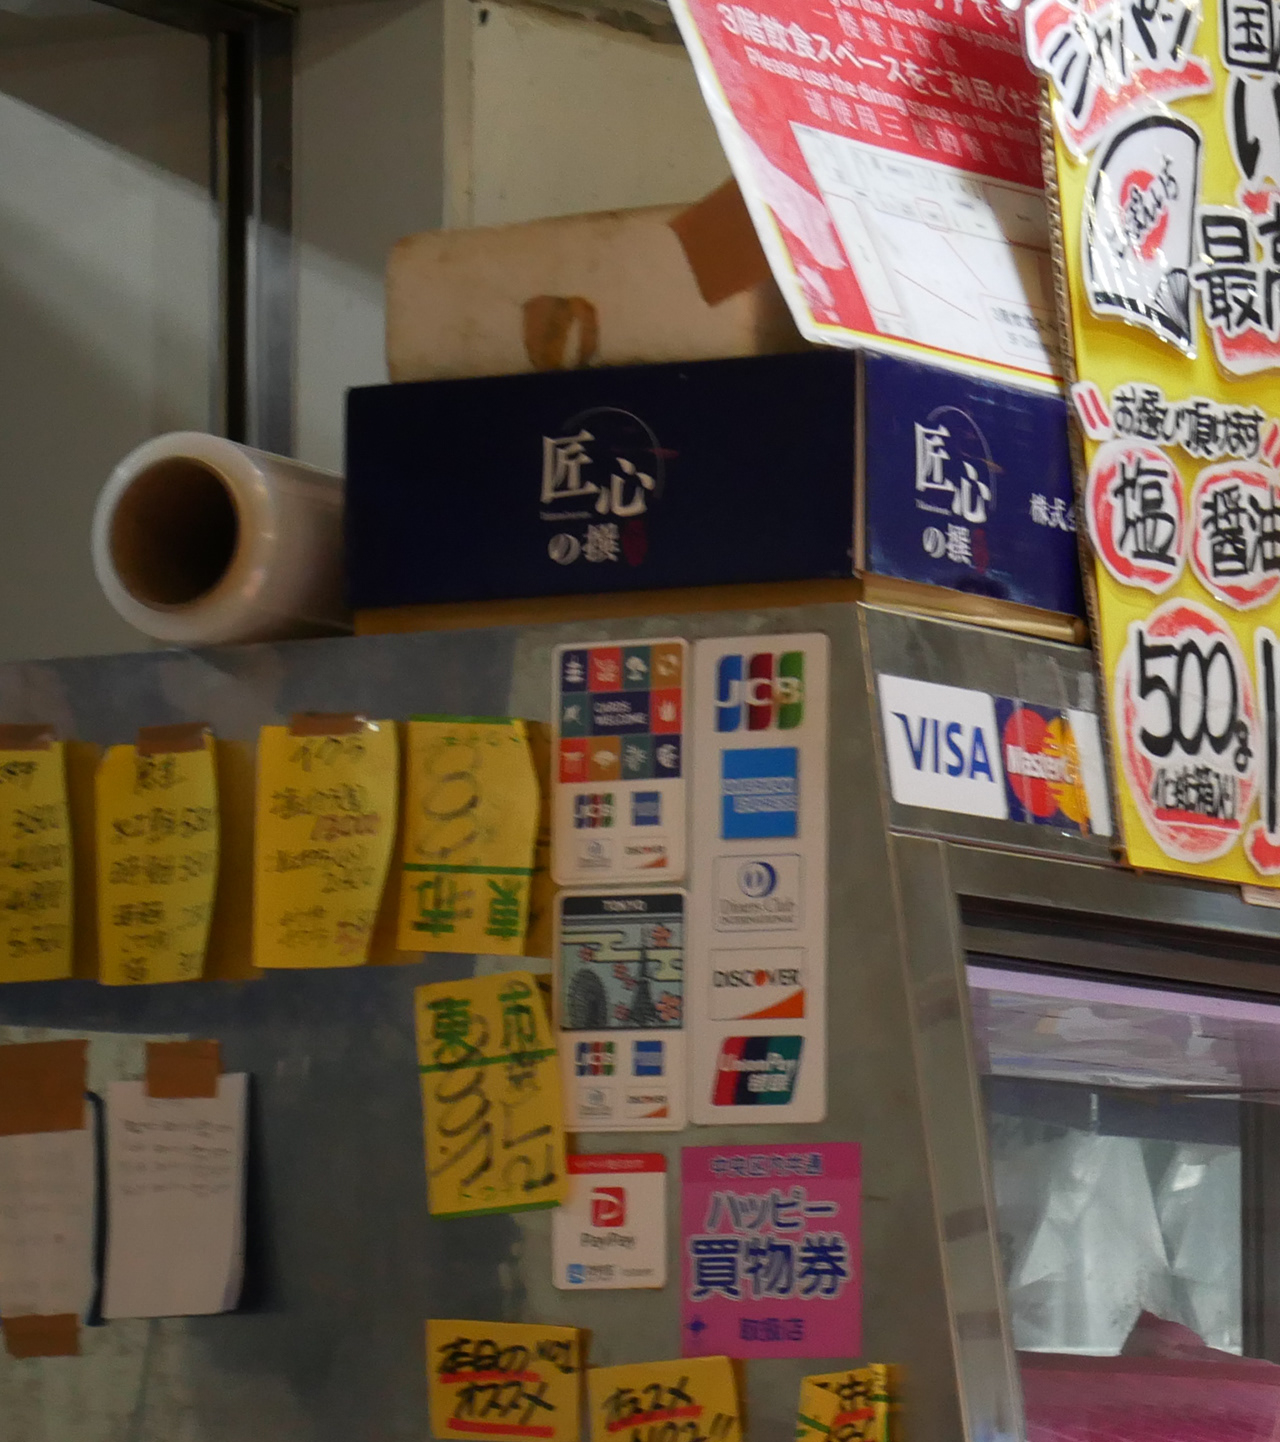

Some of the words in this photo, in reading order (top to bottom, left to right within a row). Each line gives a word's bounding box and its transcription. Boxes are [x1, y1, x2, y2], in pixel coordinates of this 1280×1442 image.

[890, 711, 996, 784] VISA
[706, 1186, 835, 1231] ハッピー
[690, 1235, 849, 1300] 買物券
